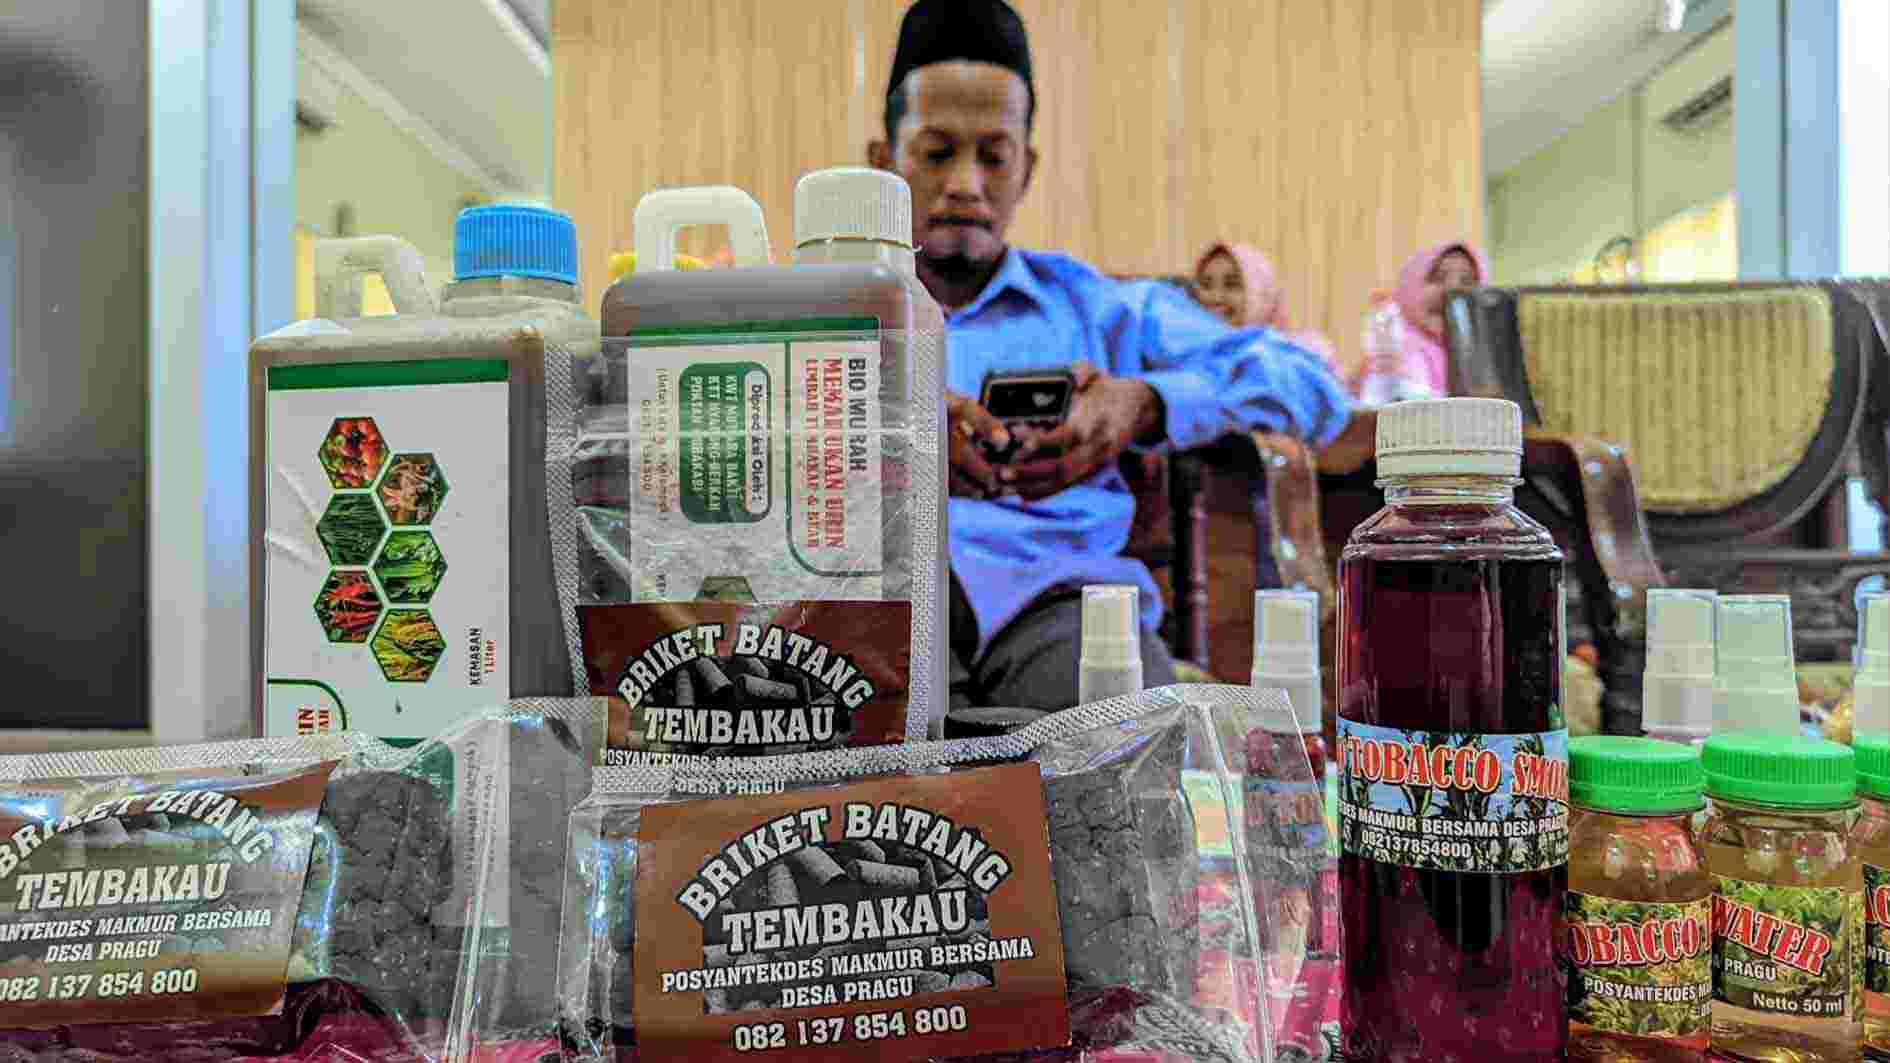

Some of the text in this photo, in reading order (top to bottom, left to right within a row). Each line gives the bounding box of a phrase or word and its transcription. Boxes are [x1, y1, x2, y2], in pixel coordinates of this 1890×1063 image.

[725, 405, 738, 460] MUTARA
[748, 384, 763, 456] Diprodksi
[849, 358, 867, 472] BIO MURAH
[469, 628, 481, 686] KEMASAN
[619, 624, 873, 709] BRIKET BATANG
[644, 706, 835, 745] TEMBAKAU
[1351, 735, 1502, 794] TOBACCO
[147, 790, 274, 863] BATANG
[1358, 807, 1417, 832] MAKMUR
[1422, 817, 1499, 838] BERSAMA
[1503, 819, 1537, 838] DESA
[1361, 829, 1472, 858] 082137854800
[678, 803, 1013, 921] BRIKET BATANG
[16, 863, 232, 911] TEMBAKAU
[95, 914, 179, 937] MAKMUR
[182, 909, 272, 932] BERSAMA
[722, 889, 970, 955] TEMBAKAU
[1568, 917, 1700, 967] OBACCO
[45, 940, 161, 963] DESA PRAGU
[661, 936, 1034, 993] POSYANTEKDES MAKMUR BERSAMA
[1724, 959, 1777, 981] PRAGU
[48, 974, 93, 999] 137
[98, 972, 144, 997] 854
[151, 969, 198, 993] 800
[781, 976, 914, 1009] DESA PRAGU
[1584, 976, 1696, 1001] POSYANTEKDES
[1753, 993, 1798, 1011] Netto
[1803, 999, 1821, 1013] 50
[735, 1006, 968, 1052] 082 137 854 800
